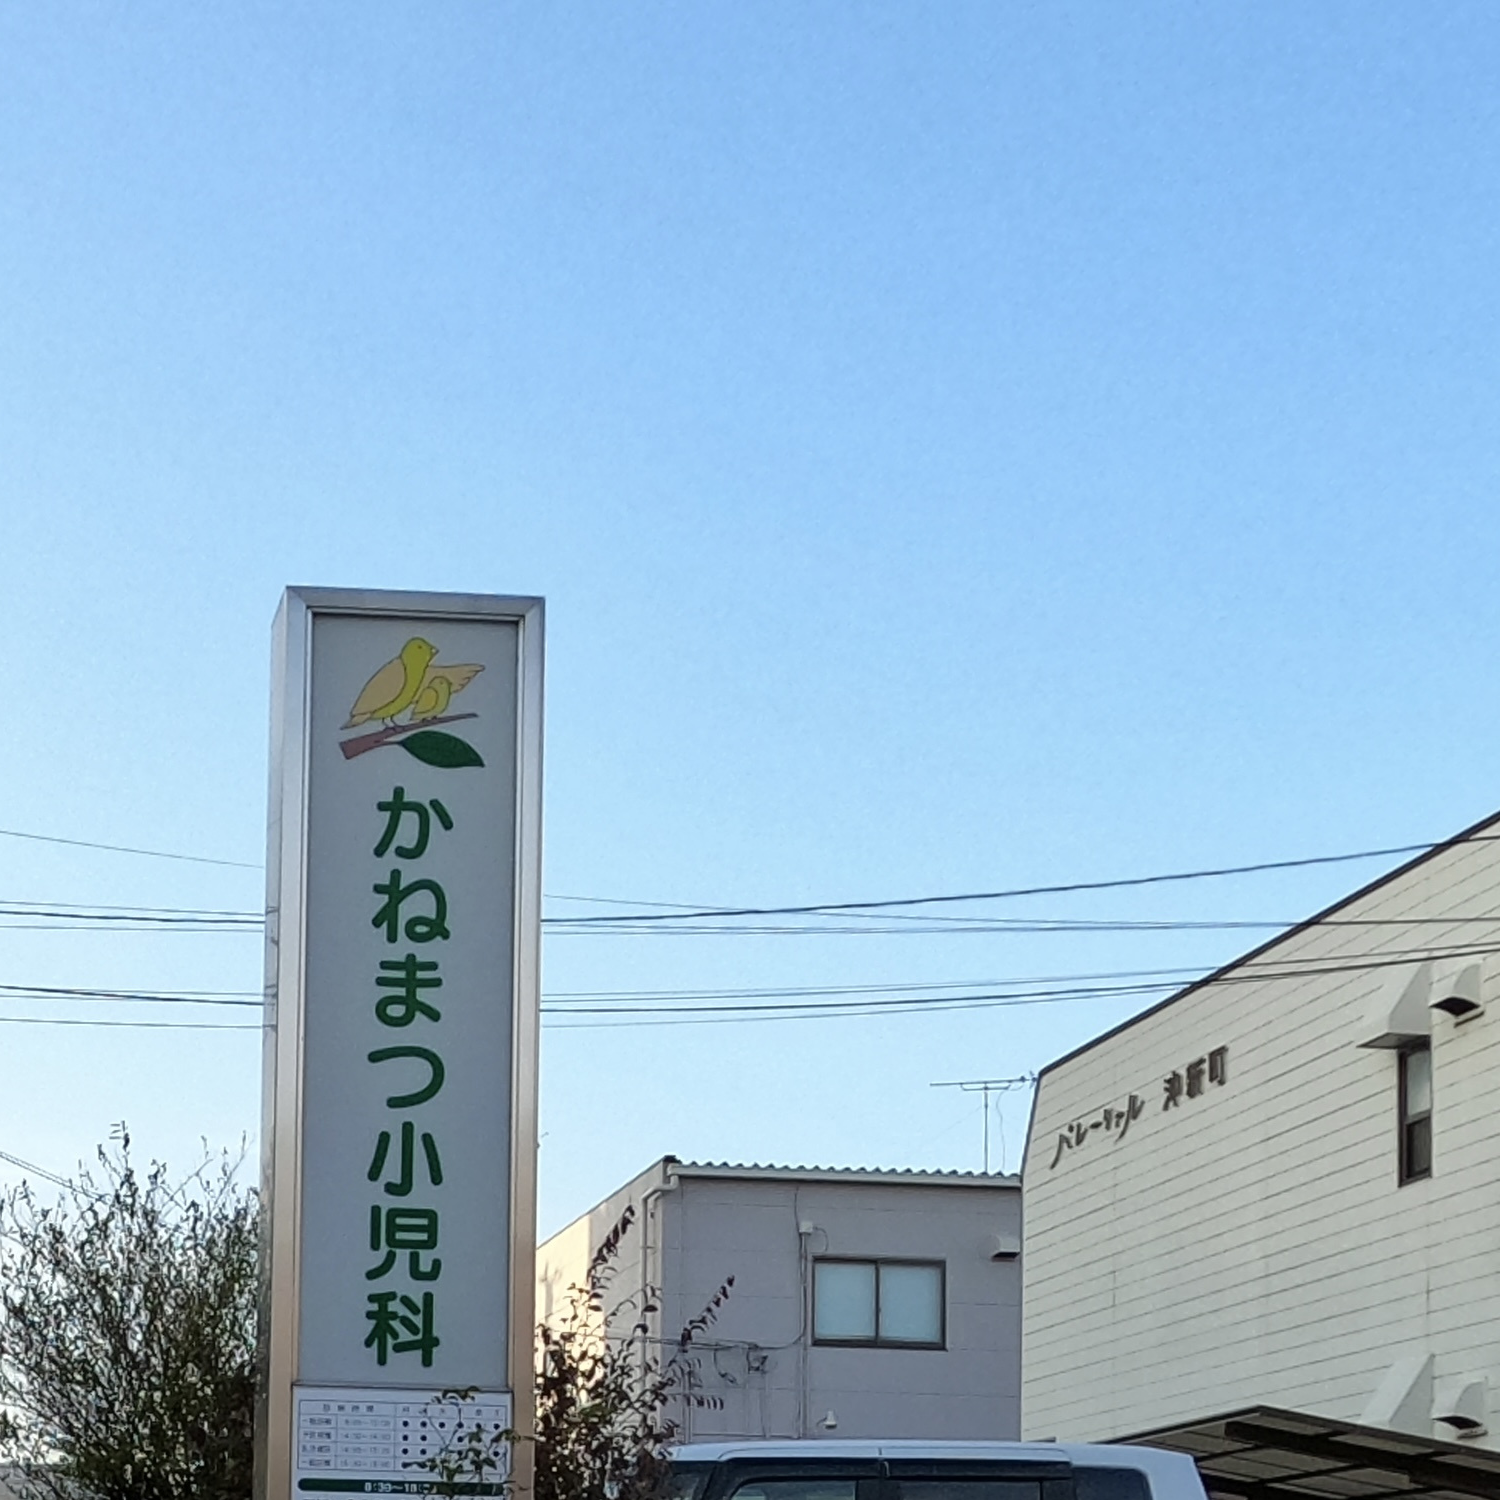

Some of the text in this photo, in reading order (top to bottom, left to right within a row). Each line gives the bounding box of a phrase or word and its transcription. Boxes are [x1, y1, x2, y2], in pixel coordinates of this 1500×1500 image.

[364, 785, 454, 1368] かねまつ小児科
